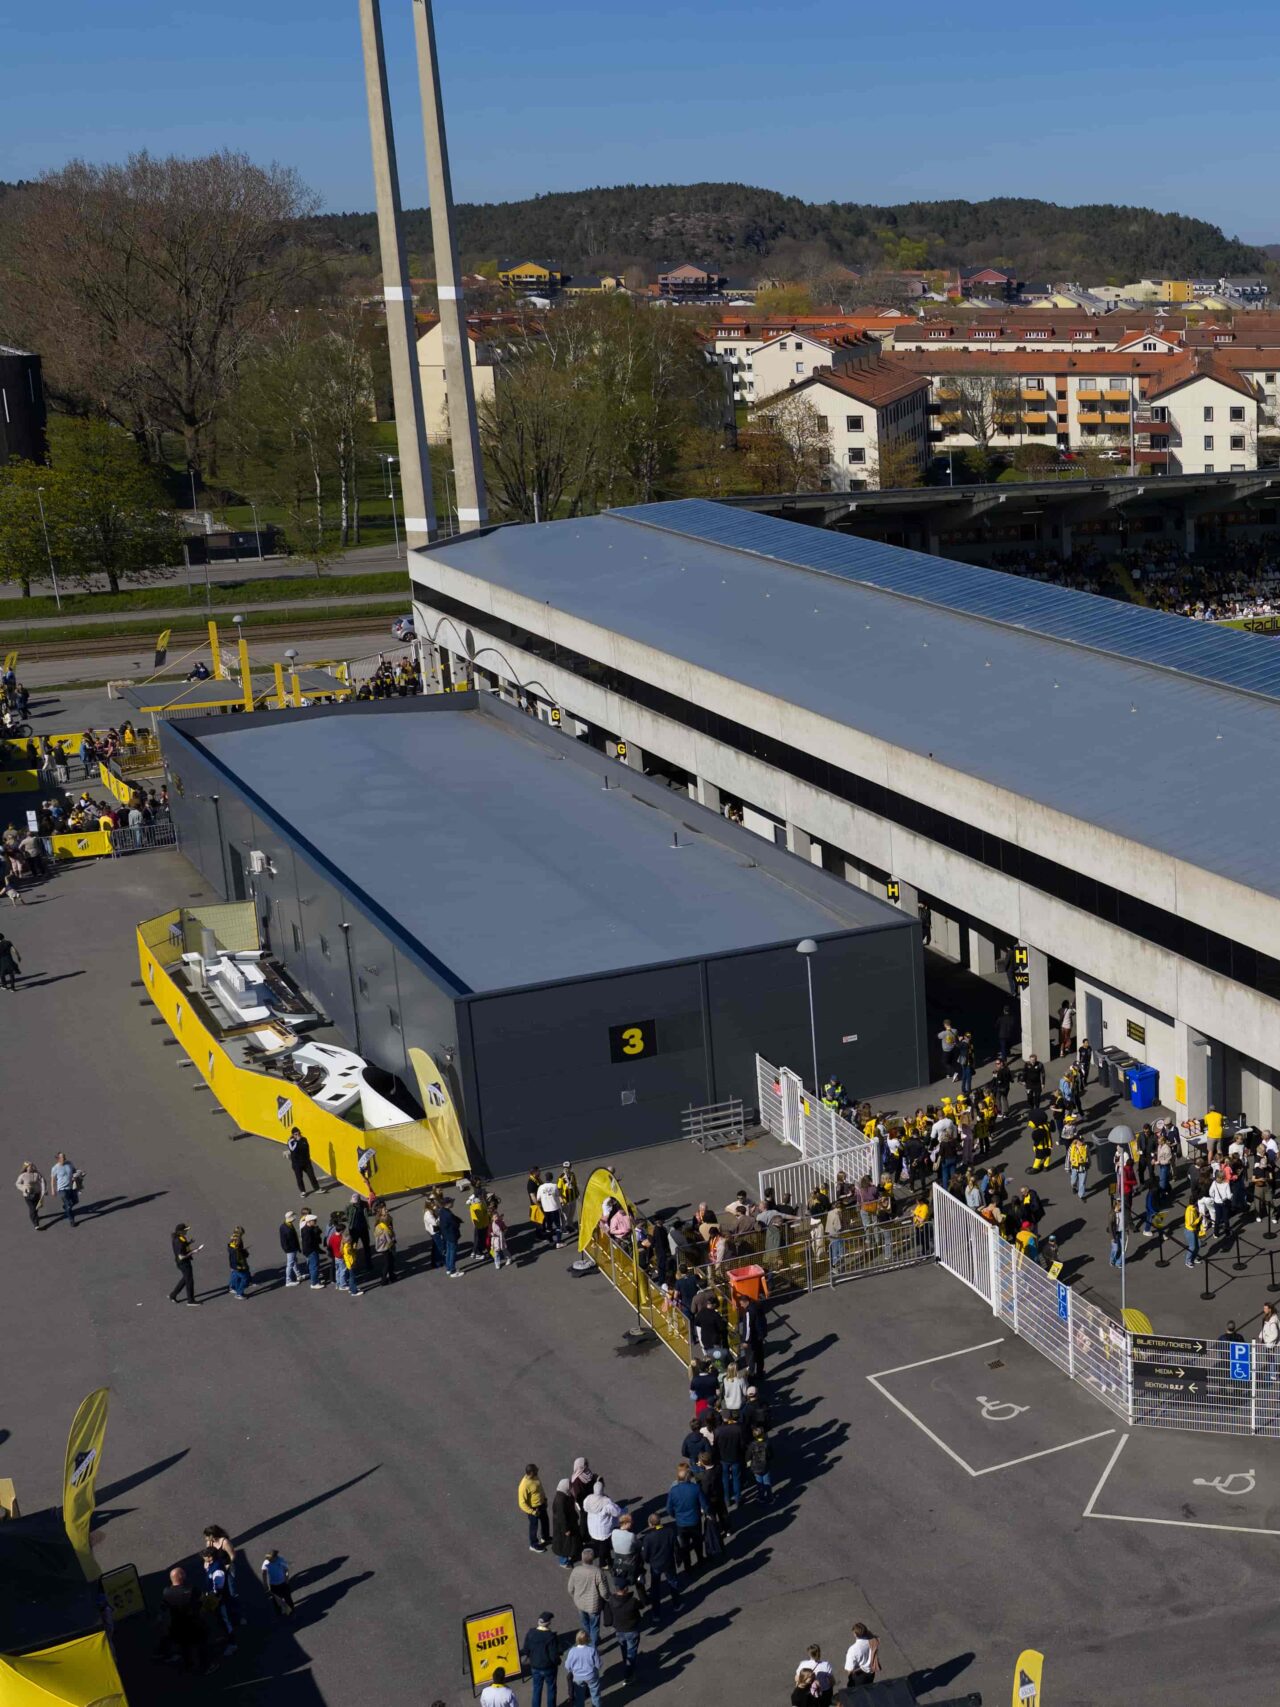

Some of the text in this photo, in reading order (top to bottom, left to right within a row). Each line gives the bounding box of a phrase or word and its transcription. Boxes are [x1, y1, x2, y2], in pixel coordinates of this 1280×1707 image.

[552, 710, 560, 719] G
[617, 744, 626, 755] G
[888, 883, 899, 897] H
[1015, 949, 1027, 964] H
[622, 1028, 644, 1055] 3
[1059, 1285, 1066, 1300] P
[1136, 1338, 1192, 1350] BILJETTER/TICKETS
[1235, 1345, 1246, 1359] P
[1155, 1367, 1173, 1375] MEDIA
[1144, 1381, 1169, 1390] SEKTION
[477, 1626, 505, 1642] BKH
[476, 1635, 509, 1653] SHOP
